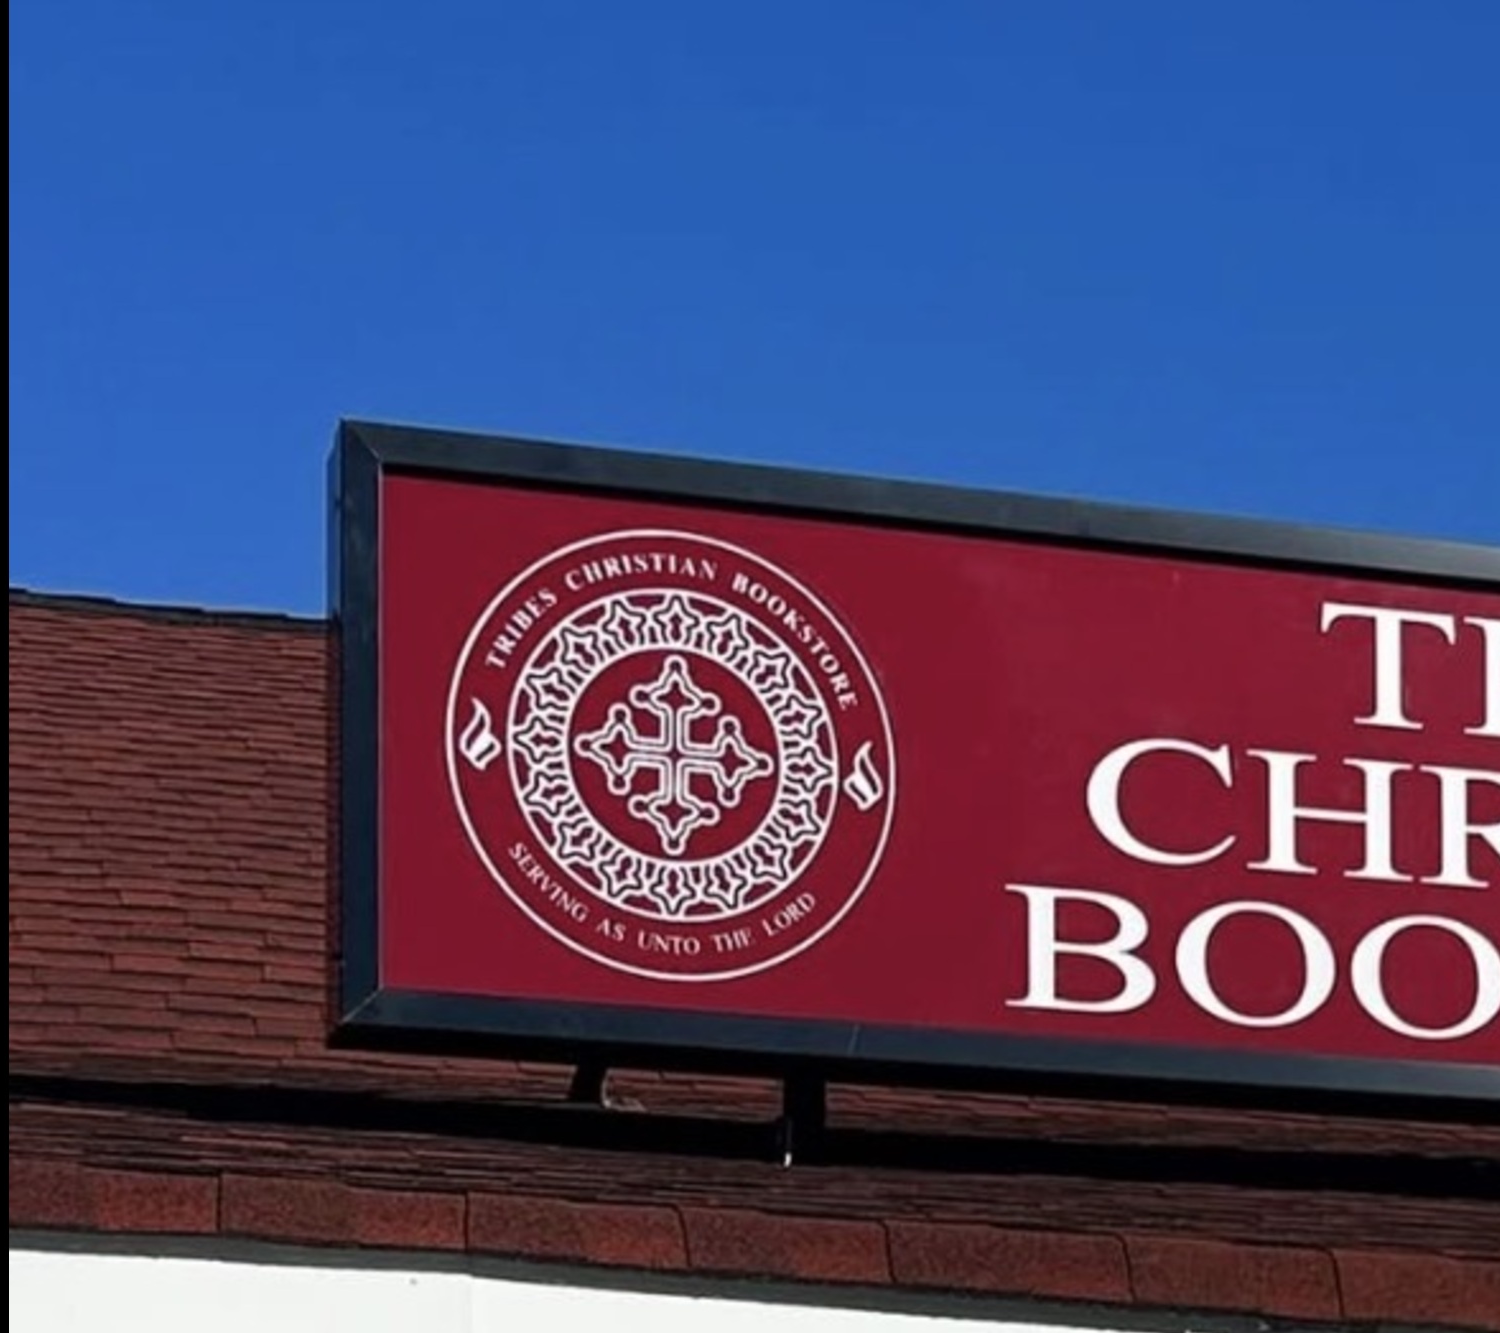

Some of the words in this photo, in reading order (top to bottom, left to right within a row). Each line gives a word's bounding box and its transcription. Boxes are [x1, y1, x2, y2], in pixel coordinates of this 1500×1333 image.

[485, 588, 558, 669] TRIBES
[564, 552, 718, 592] CHRISTIAN
[731, 572, 858, 711] BOOKSTORE
[508, 841, 589, 923] SERVING
[596, 918, 627, 942] AS
[637, 929, 702, 956] UNTO
[709, 928, 752, 953] THE
[761, 892, 816, 938] LORD
